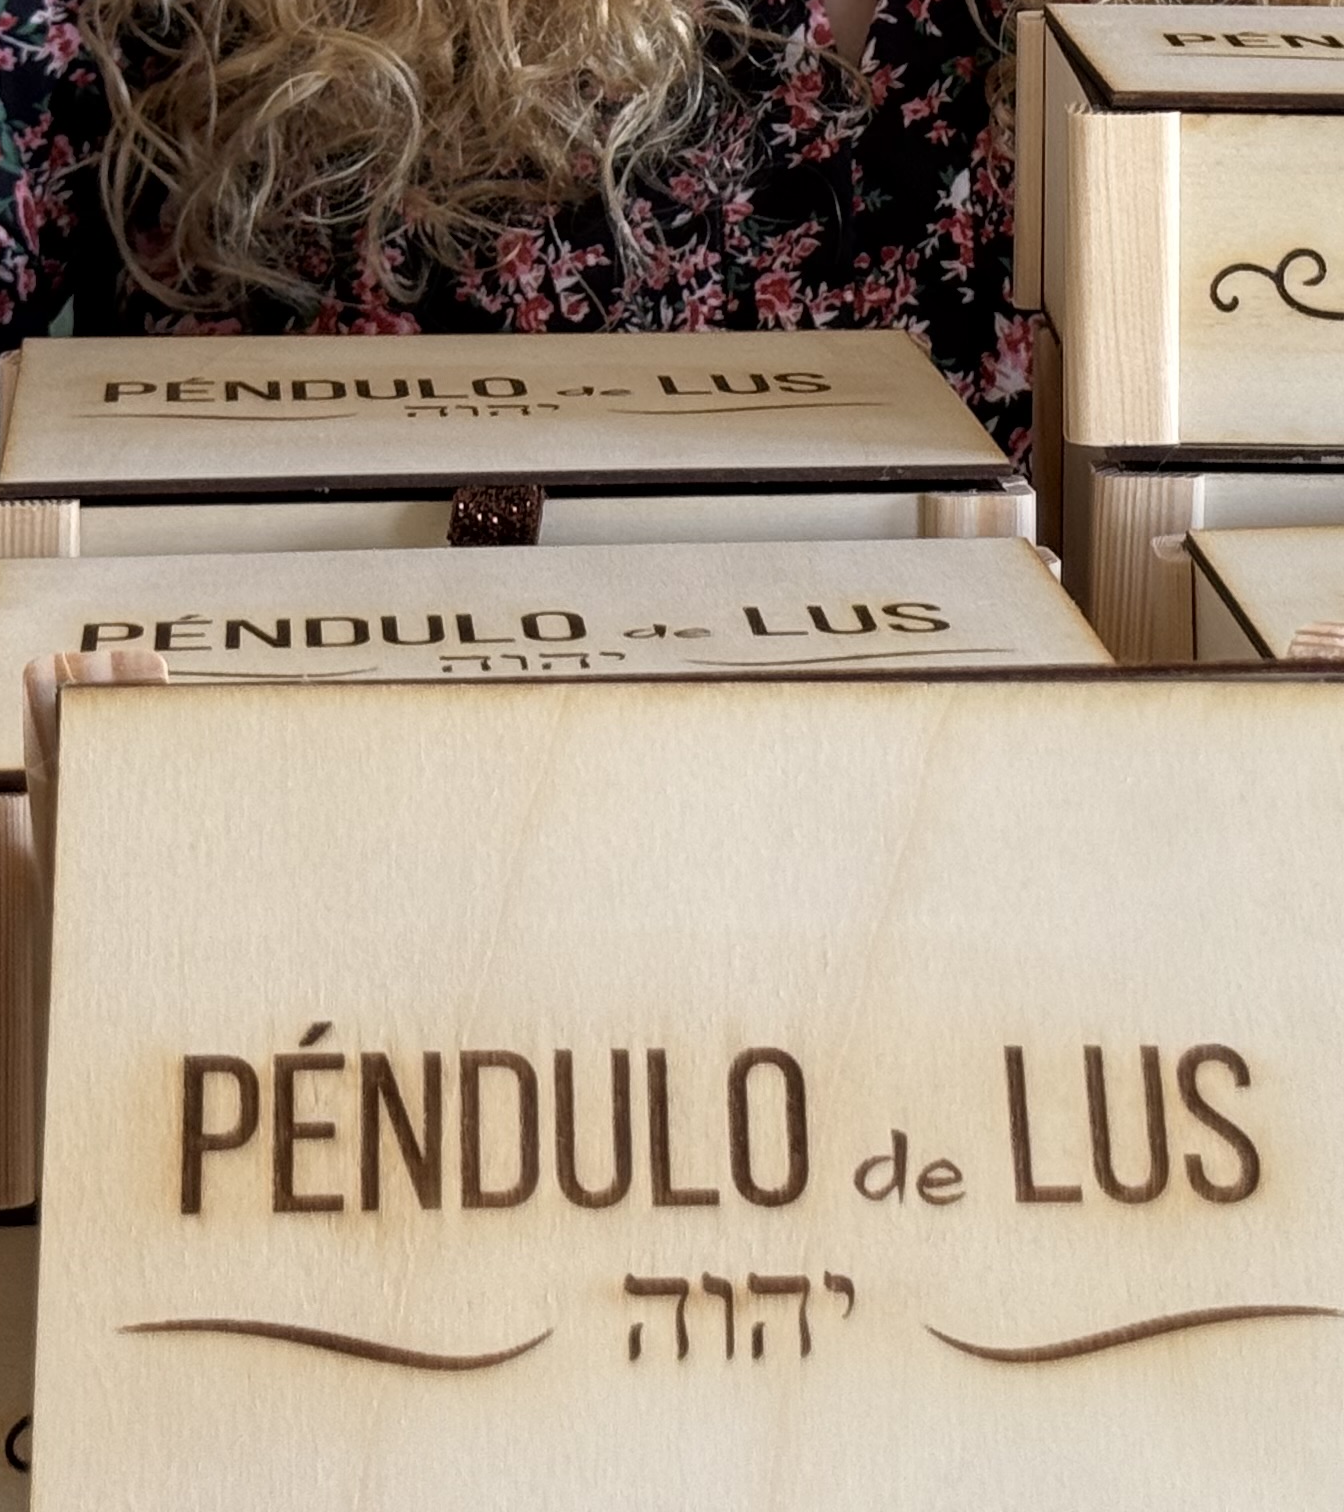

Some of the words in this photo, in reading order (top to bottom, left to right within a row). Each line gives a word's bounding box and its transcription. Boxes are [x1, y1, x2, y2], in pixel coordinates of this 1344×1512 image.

[102, 376, 527, 403] PÉNDULO
[657, 371, 833, 395] LUS
[80, 611, 588, 652] PÉNDULO
[622, 622, 712, 641] de
[742, 602, 950, 636] LUS
[180, 1021, 811, 1215] PÉNDULO
[853, 1128, 966, 1206] de
[1003, 1043, 1259, 1206] LUS
